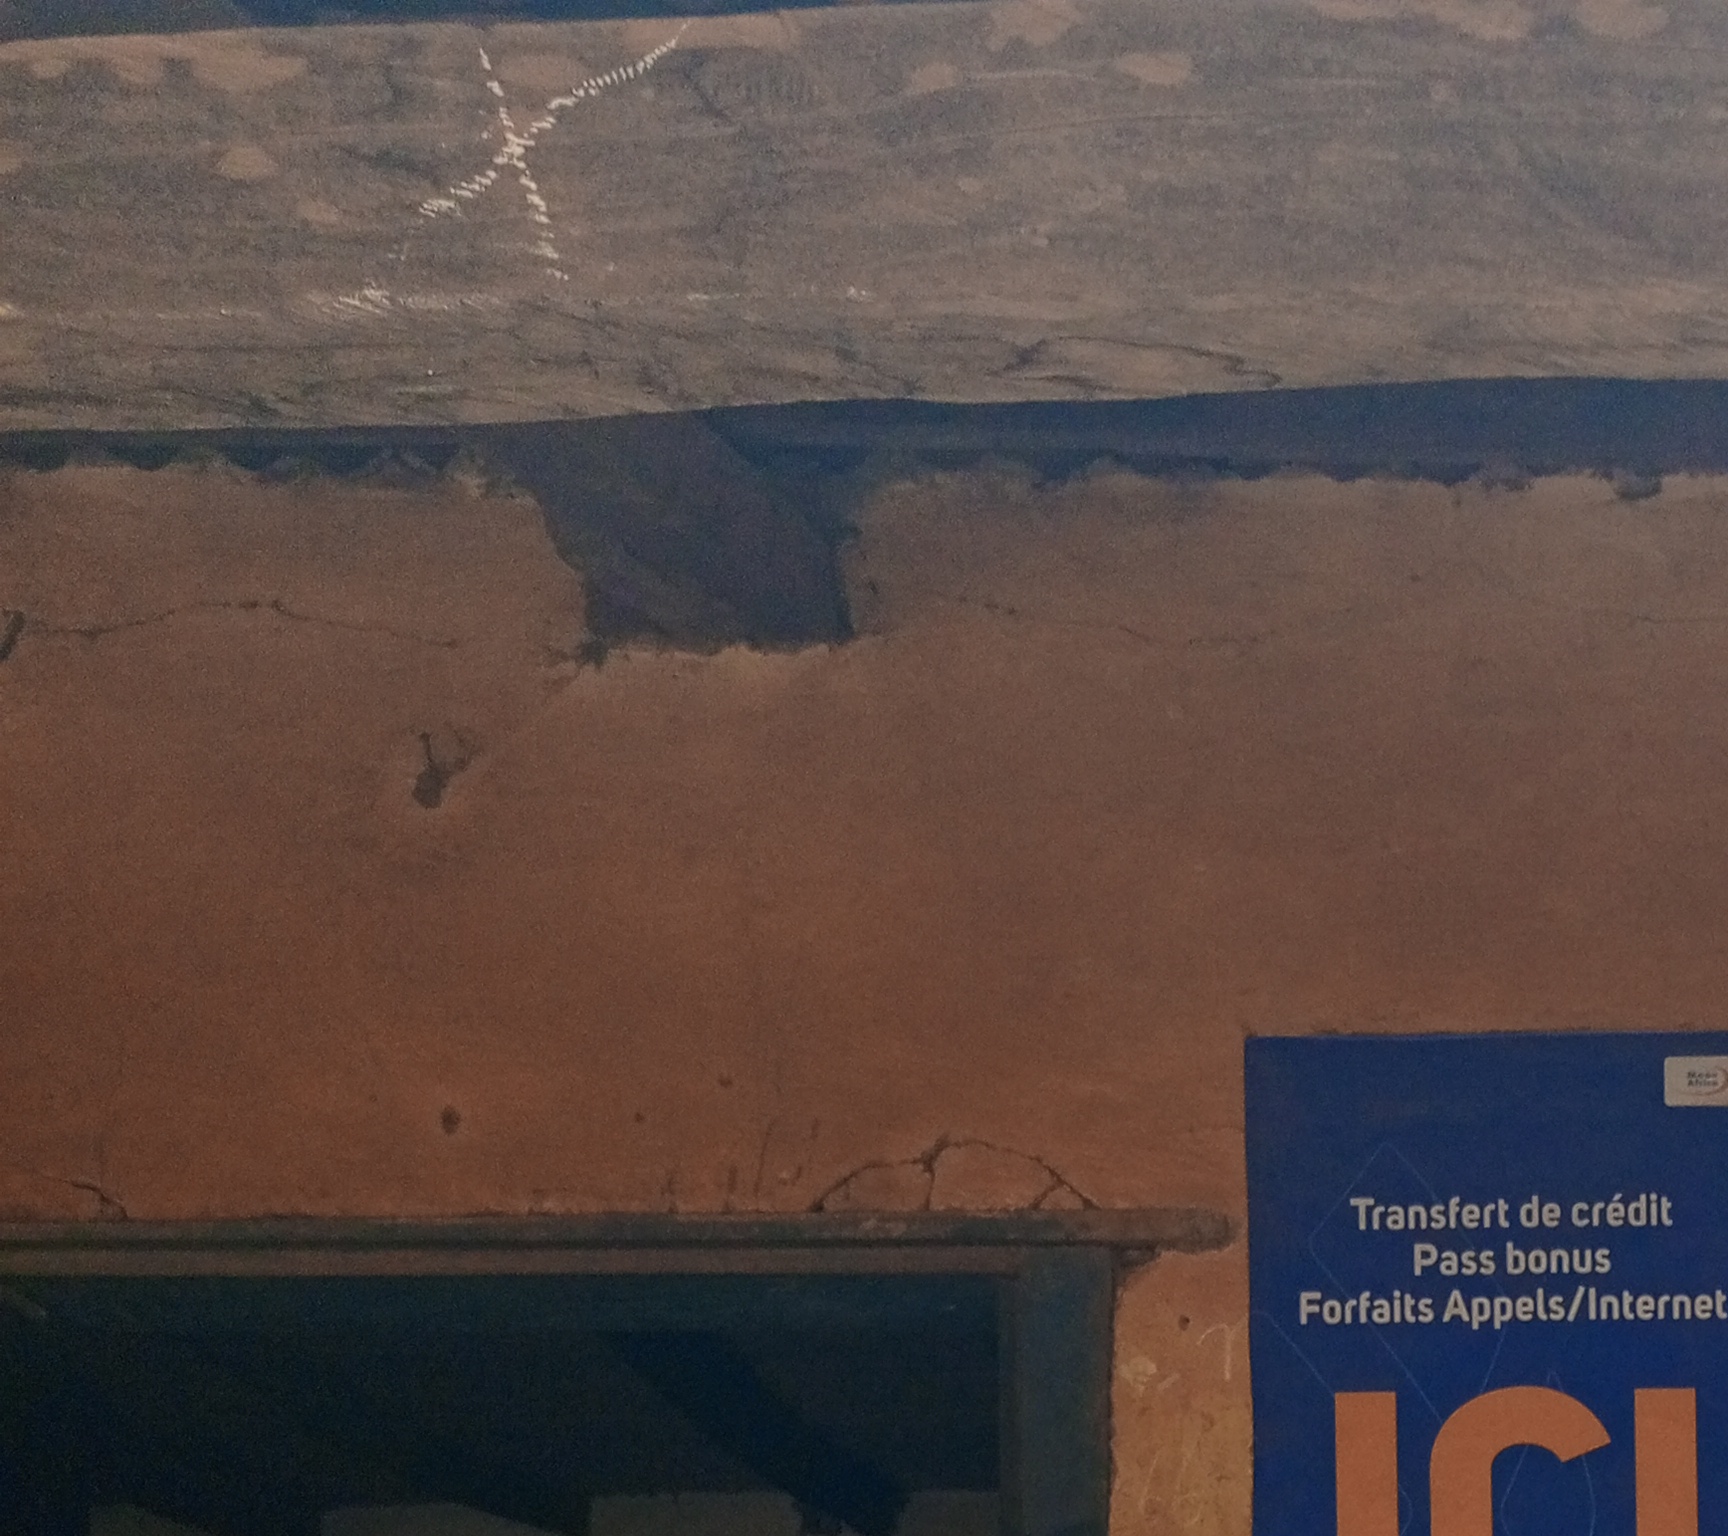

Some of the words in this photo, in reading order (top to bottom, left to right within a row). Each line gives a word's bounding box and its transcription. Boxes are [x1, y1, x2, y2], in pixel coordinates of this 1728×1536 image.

[1349, 1195, 1510, 1231] Transfert
[1519, 1194, 1561, 1228] de
[1571, 1192, 1673, 1228] crédit
[1413, 1243, 1496, 1277] Pass
[1506, 1241, 1611, 1275] bonus
[1299, 1289, 1435, 1325] Forfaits
[1442, 1285, 1728, 1330] Appels/Internet
